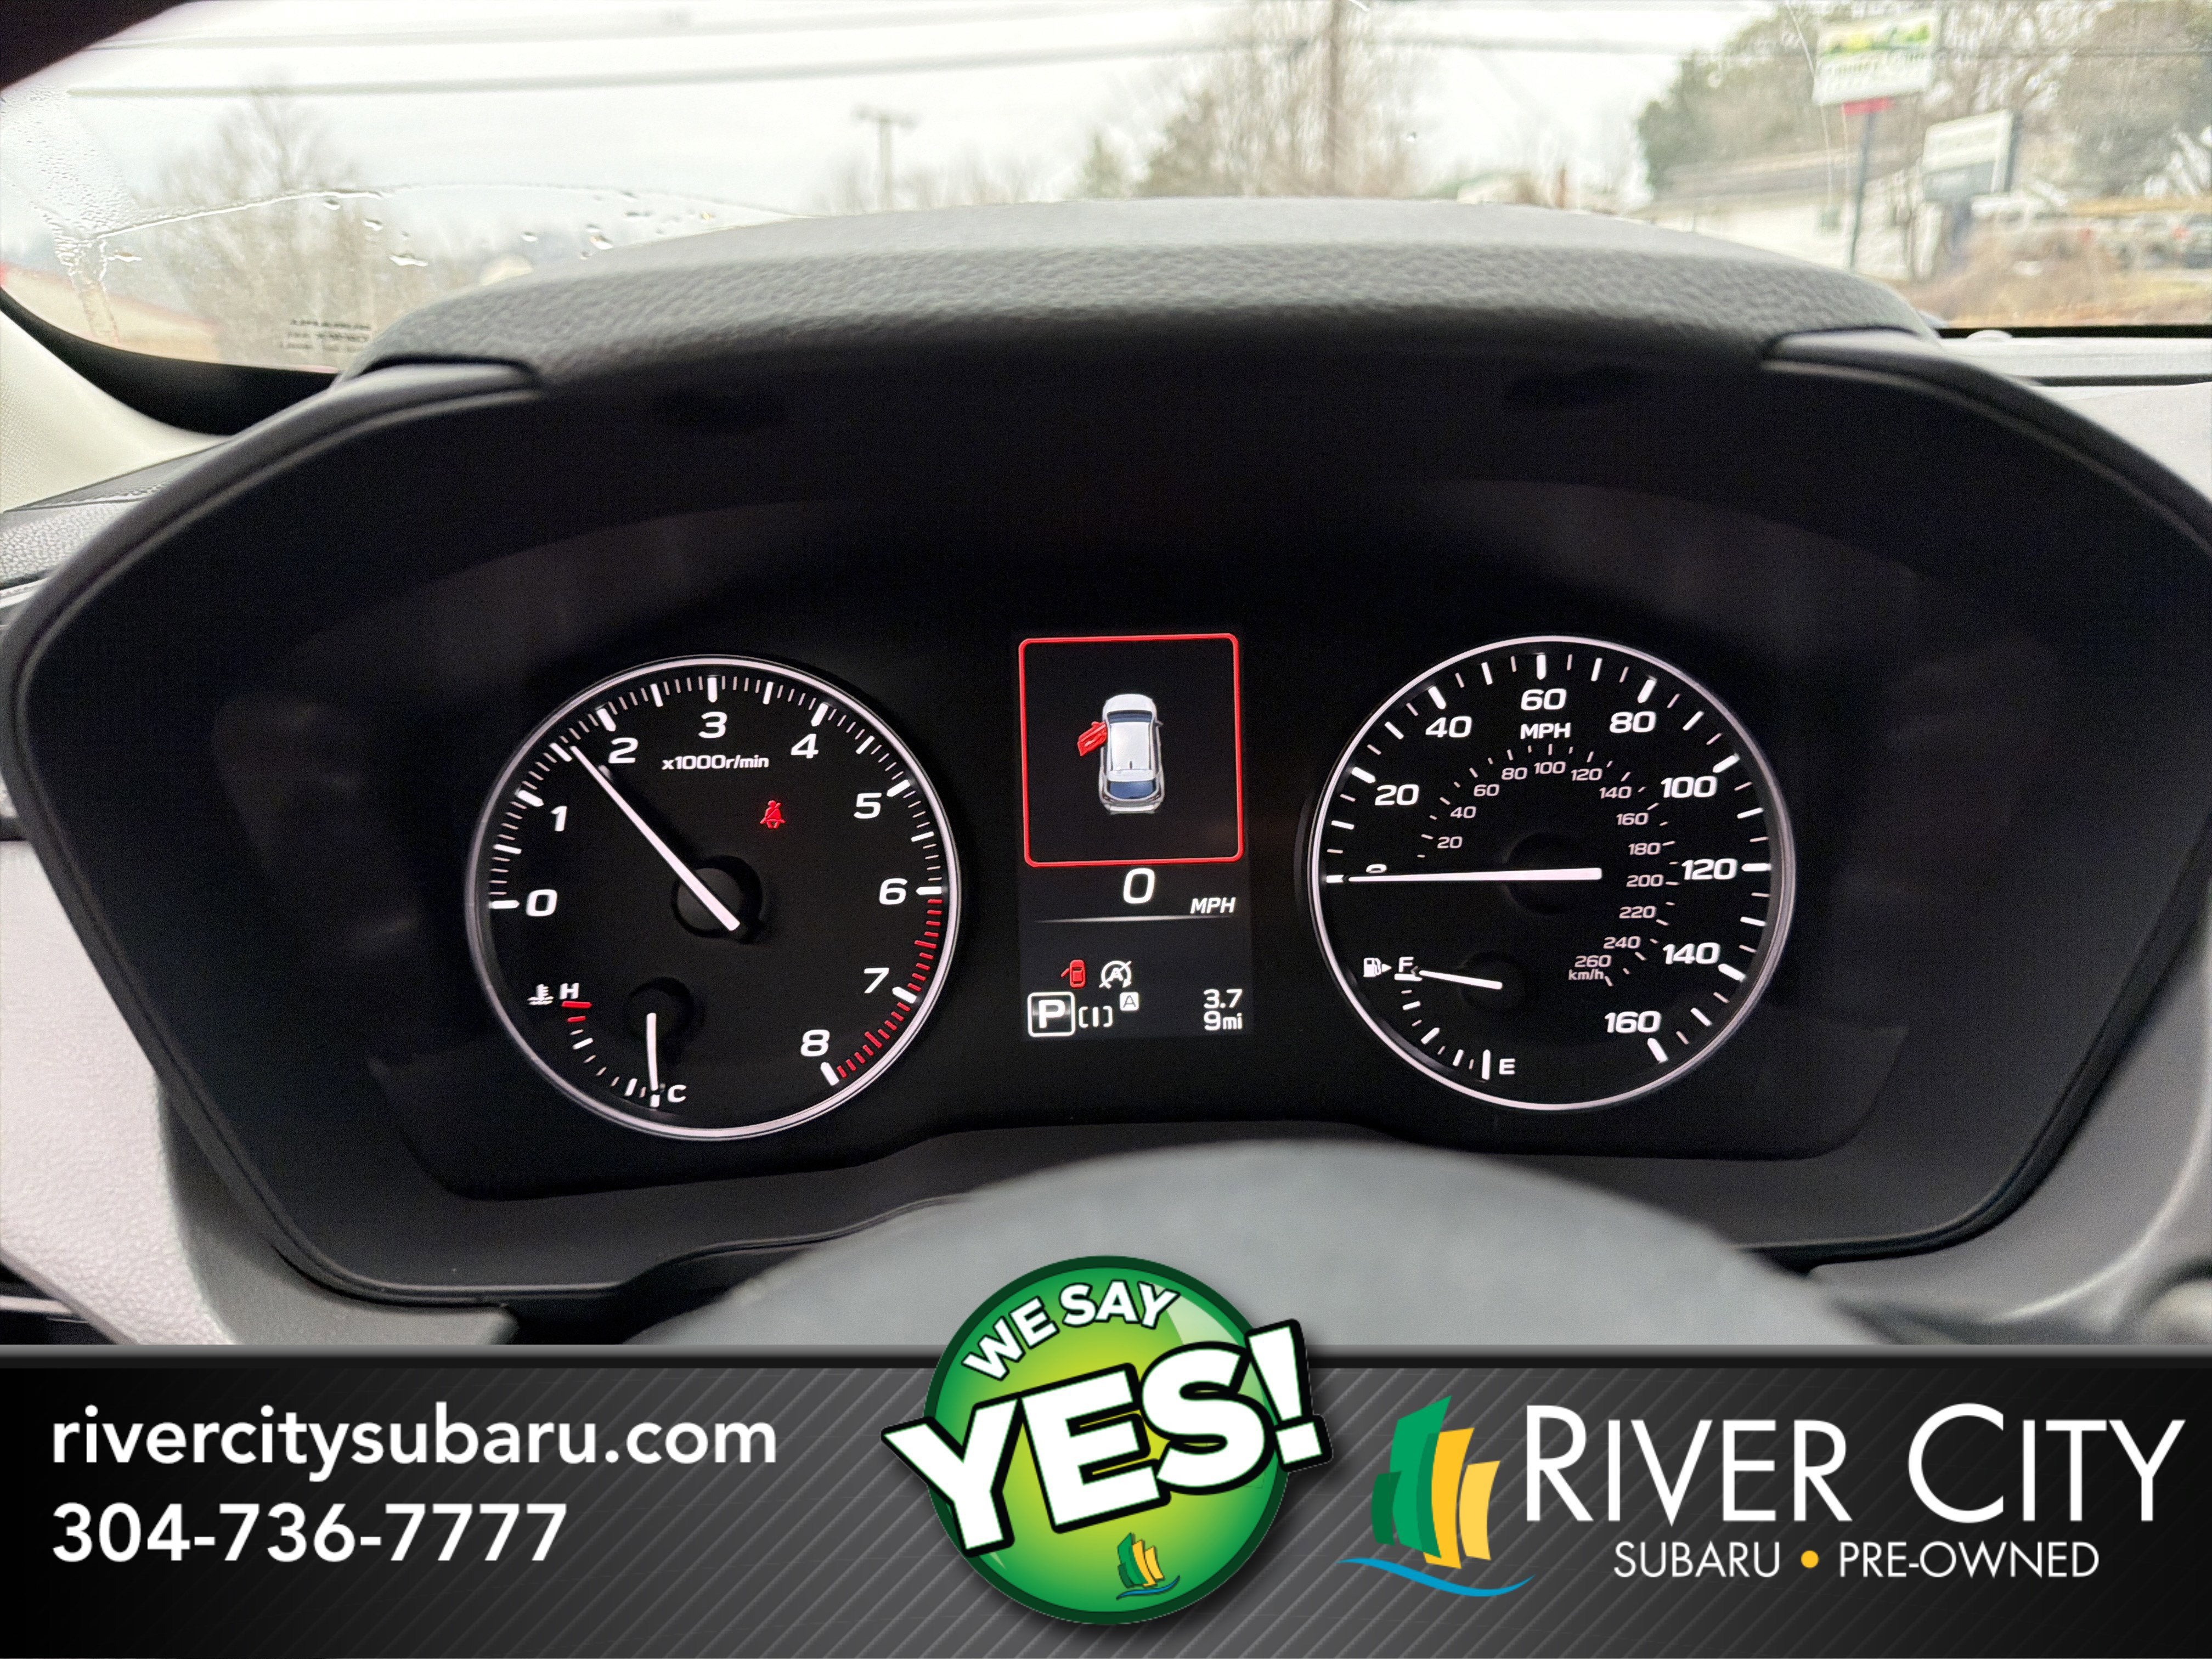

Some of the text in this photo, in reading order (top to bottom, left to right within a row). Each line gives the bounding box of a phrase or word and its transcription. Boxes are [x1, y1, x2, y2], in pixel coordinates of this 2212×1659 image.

[1521, 689, 1566, 710] 60
[698, 712, 727, 738] 3
[1426, 716, 1472, 737] 40
[1521, 723, 1571, 739] MPH
[1610, 712, 1656, 733] 80
[608, 737, 638, 763] 2
[791, 733, 819, 759] 4
[662, 755, 769, 770] x1000r/min
[1534, 761, 1566, 774] 100
[1502, 768, 1527, 780] 80
[1571, 769, 1602, 781] 120
[1375, 785, 1419, 805] 20
[1474, 784, 1499, 797] 60
[1600, 786, 1631, 798] 140
[1661, 776, 1717, 798] 100
[854, 793, 882, 819] 5
[1451, 806, 1476, 819] 40
[551, 806, 567, 831] 1
[1616, 812, 1647, 825] 160
[1437, 837, 1462, 848] 20
[1629, 843, 1660, 855] 180
[1681, 859, 1737, 880] 120
[1123, 868, 1155, 904] 0
[1627, 874, 1663, 887] 200
[879, 878, 907, 905] 6
[526, 889, 557, 916] 0
[1190, 897, 1235, 915] MPH
[1619, 906, 1655, 919] 220
[1604, 936, 1640, 949] 240
[1575, 956, 1611, 968] 260
[1663, 943, 1720, 964] 140
[1398, 957, 1414, 971] F
[864, 968, 889, 993] 7
[1568, 968, 1604, 981] km/h
[560, 983, 579, 1000] H
[1204, 989, 1242, 1009] 3.7
[1038, 1000, 1065, 1029] P
[1605, 1011, 1661, 1033] 160
[801, 1030, 830, 1057] 8
[1499, 1058, 1515, 1074] E
[668, 1085, 686, 1102] C
